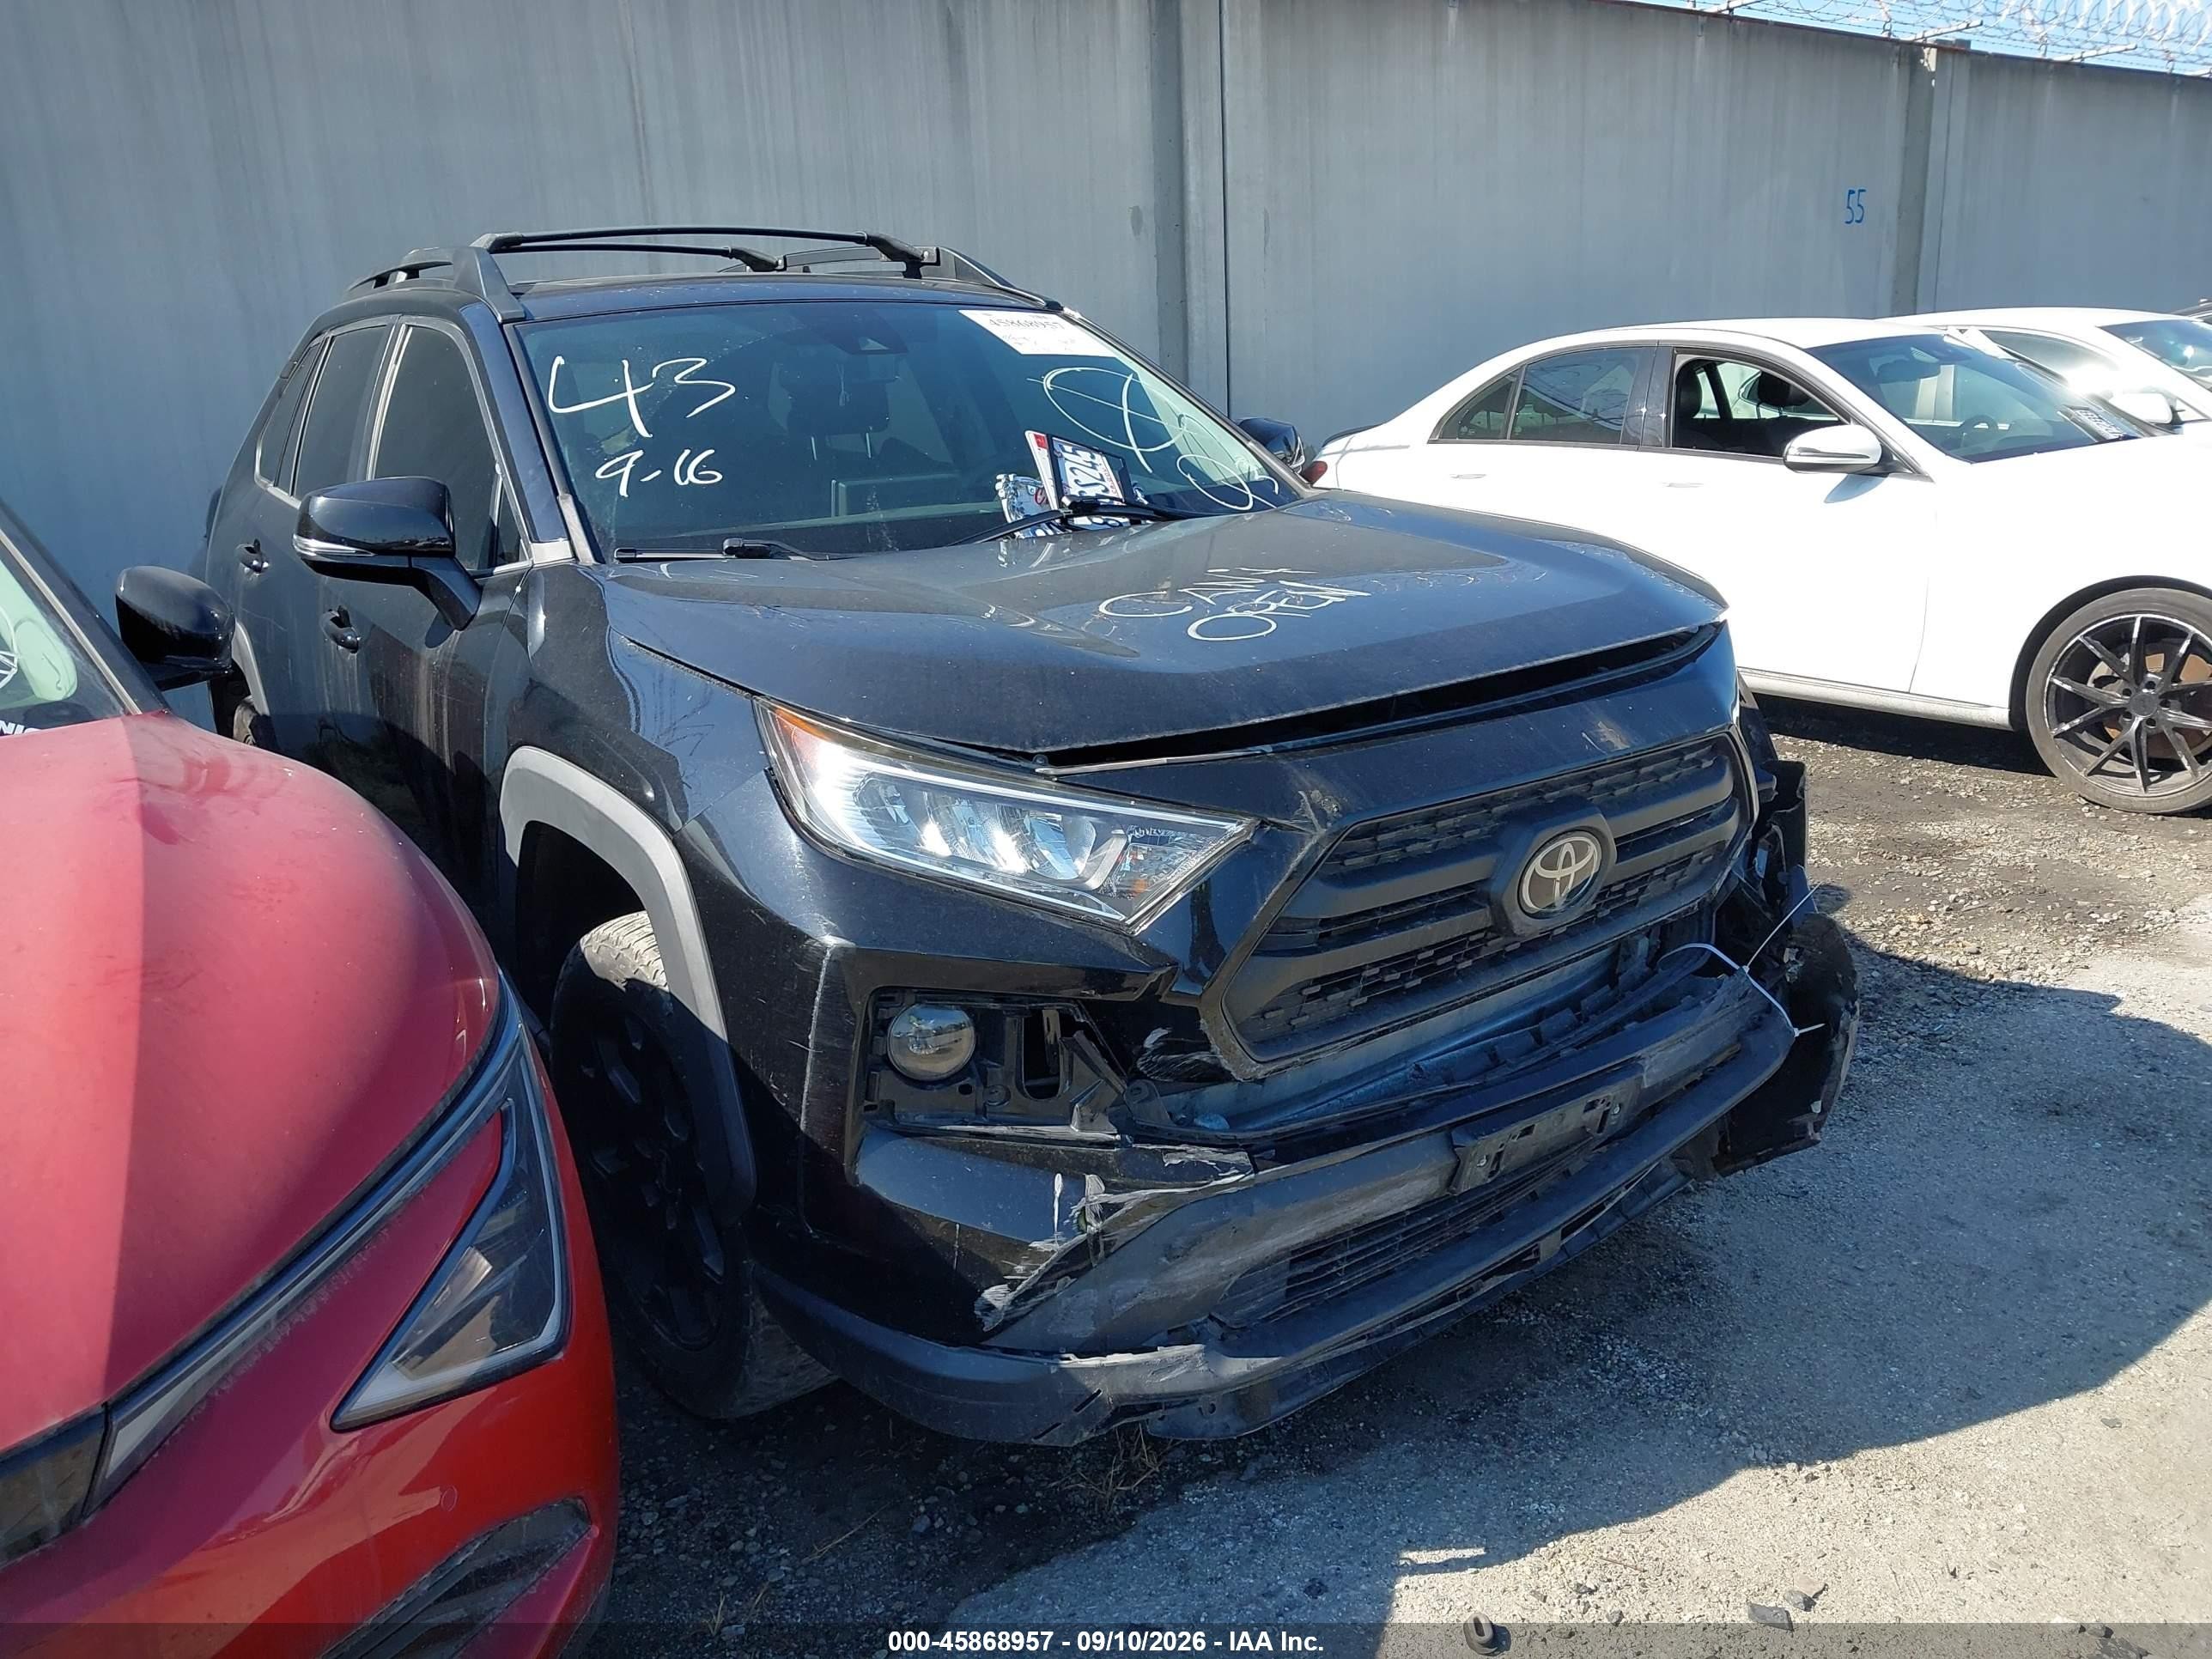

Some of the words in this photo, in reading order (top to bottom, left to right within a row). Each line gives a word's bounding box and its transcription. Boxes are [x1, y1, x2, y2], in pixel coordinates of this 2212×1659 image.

[1844, 189, 1867, 224] 55
[548, 356, 736, 439] 43
[595, 449, 723, 497] 9-16
